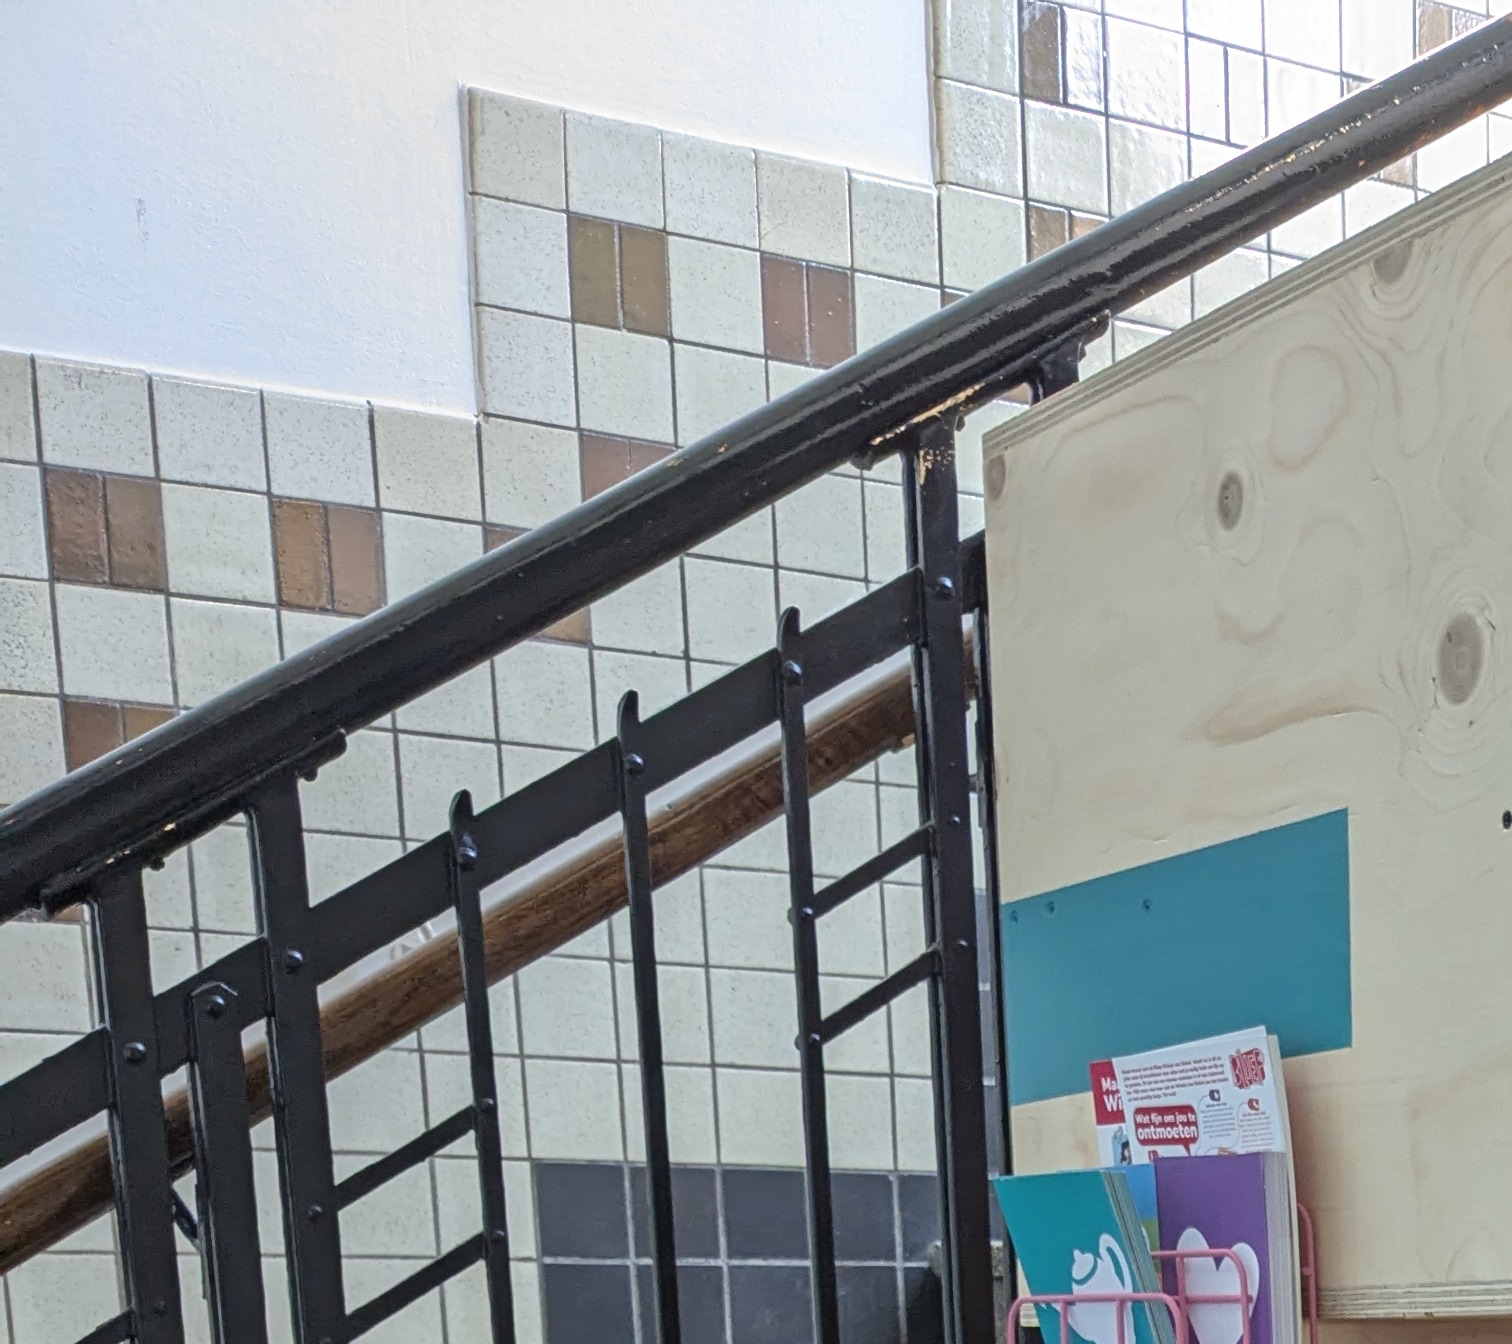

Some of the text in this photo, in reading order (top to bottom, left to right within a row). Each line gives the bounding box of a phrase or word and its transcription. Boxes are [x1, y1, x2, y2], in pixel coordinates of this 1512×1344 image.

[1101, 1077, 1117, 1092] Ma
[1103, 1094, 1123, 1113] Wi
[1135, 1112, 1196, 1125] Wat fijn om jou te
[1137, 1124, 1198, 1140] ontmoeten
